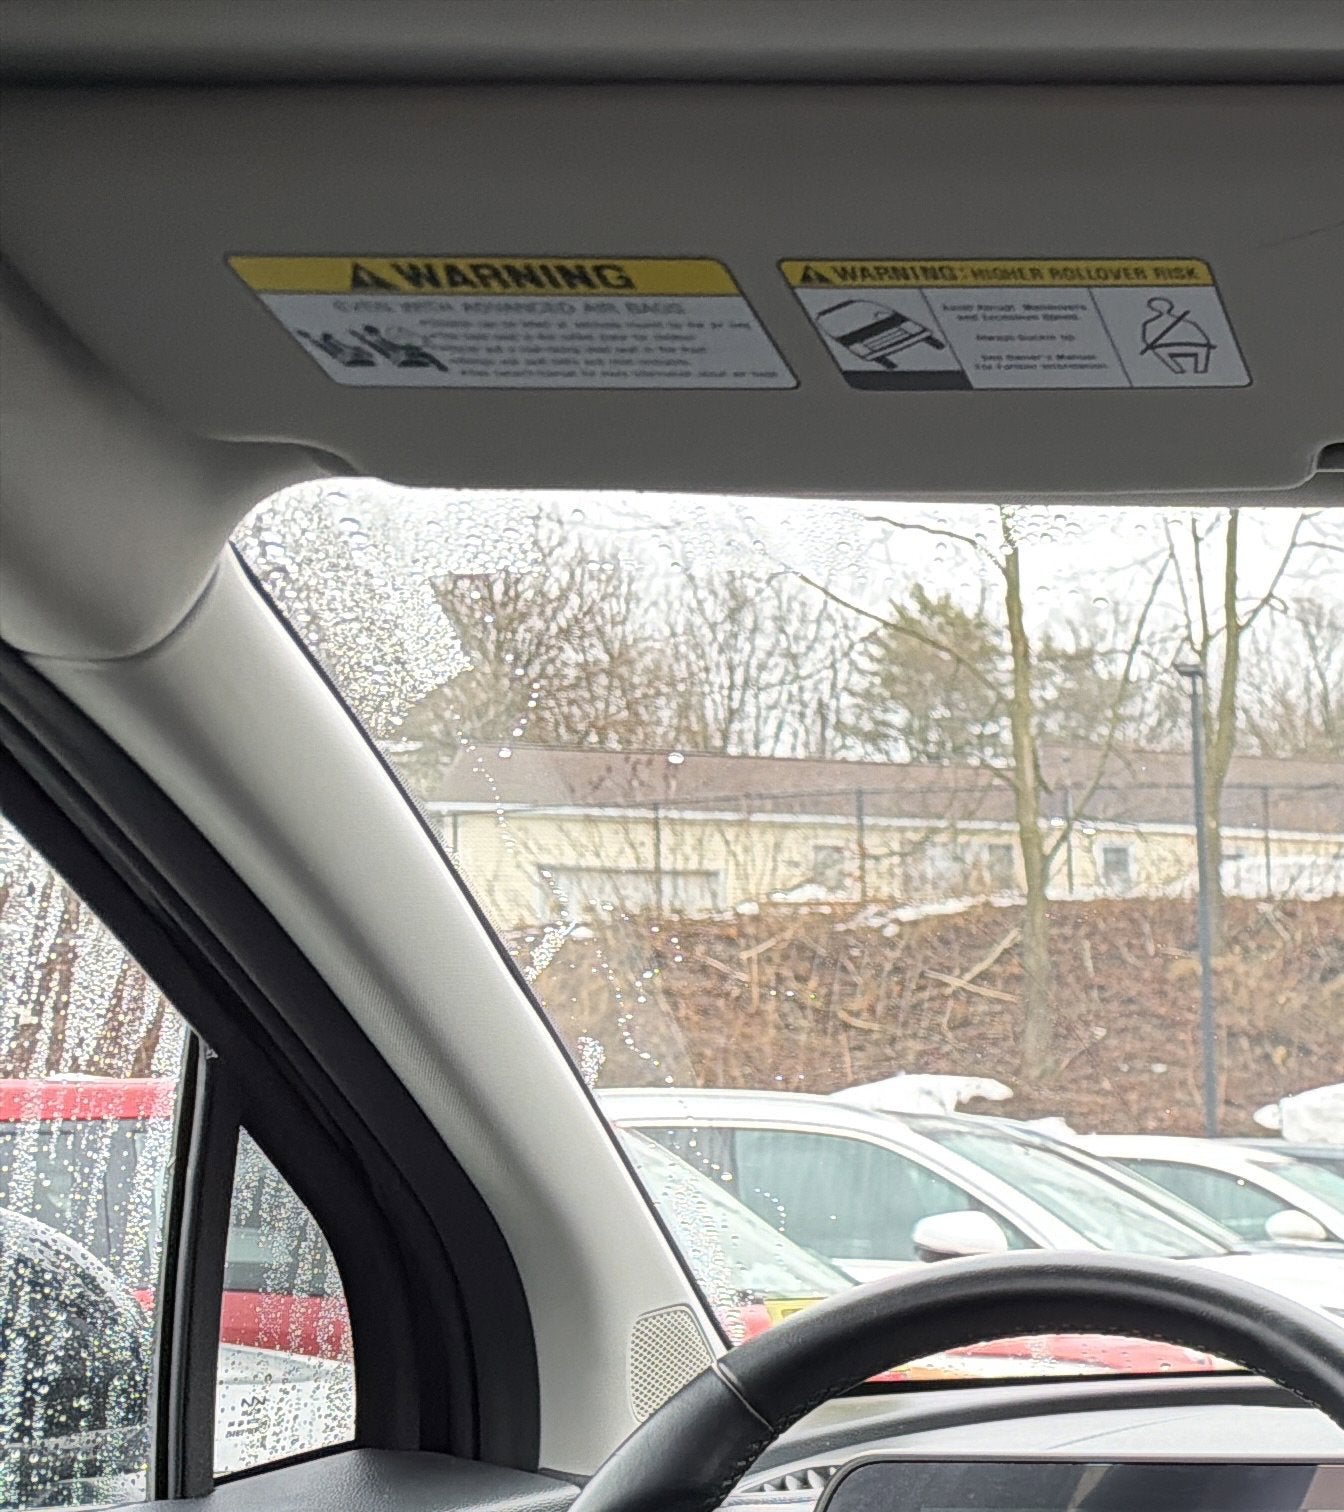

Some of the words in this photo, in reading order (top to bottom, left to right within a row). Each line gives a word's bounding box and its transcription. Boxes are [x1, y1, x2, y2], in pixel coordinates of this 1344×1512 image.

[391, 263, 636, 290] WARNING
[972, 267, 1043, 281] HIGHER
[1049, 267, 1146, 282] ROLLOVER
[1154, 267, 1200, 281] RISK
